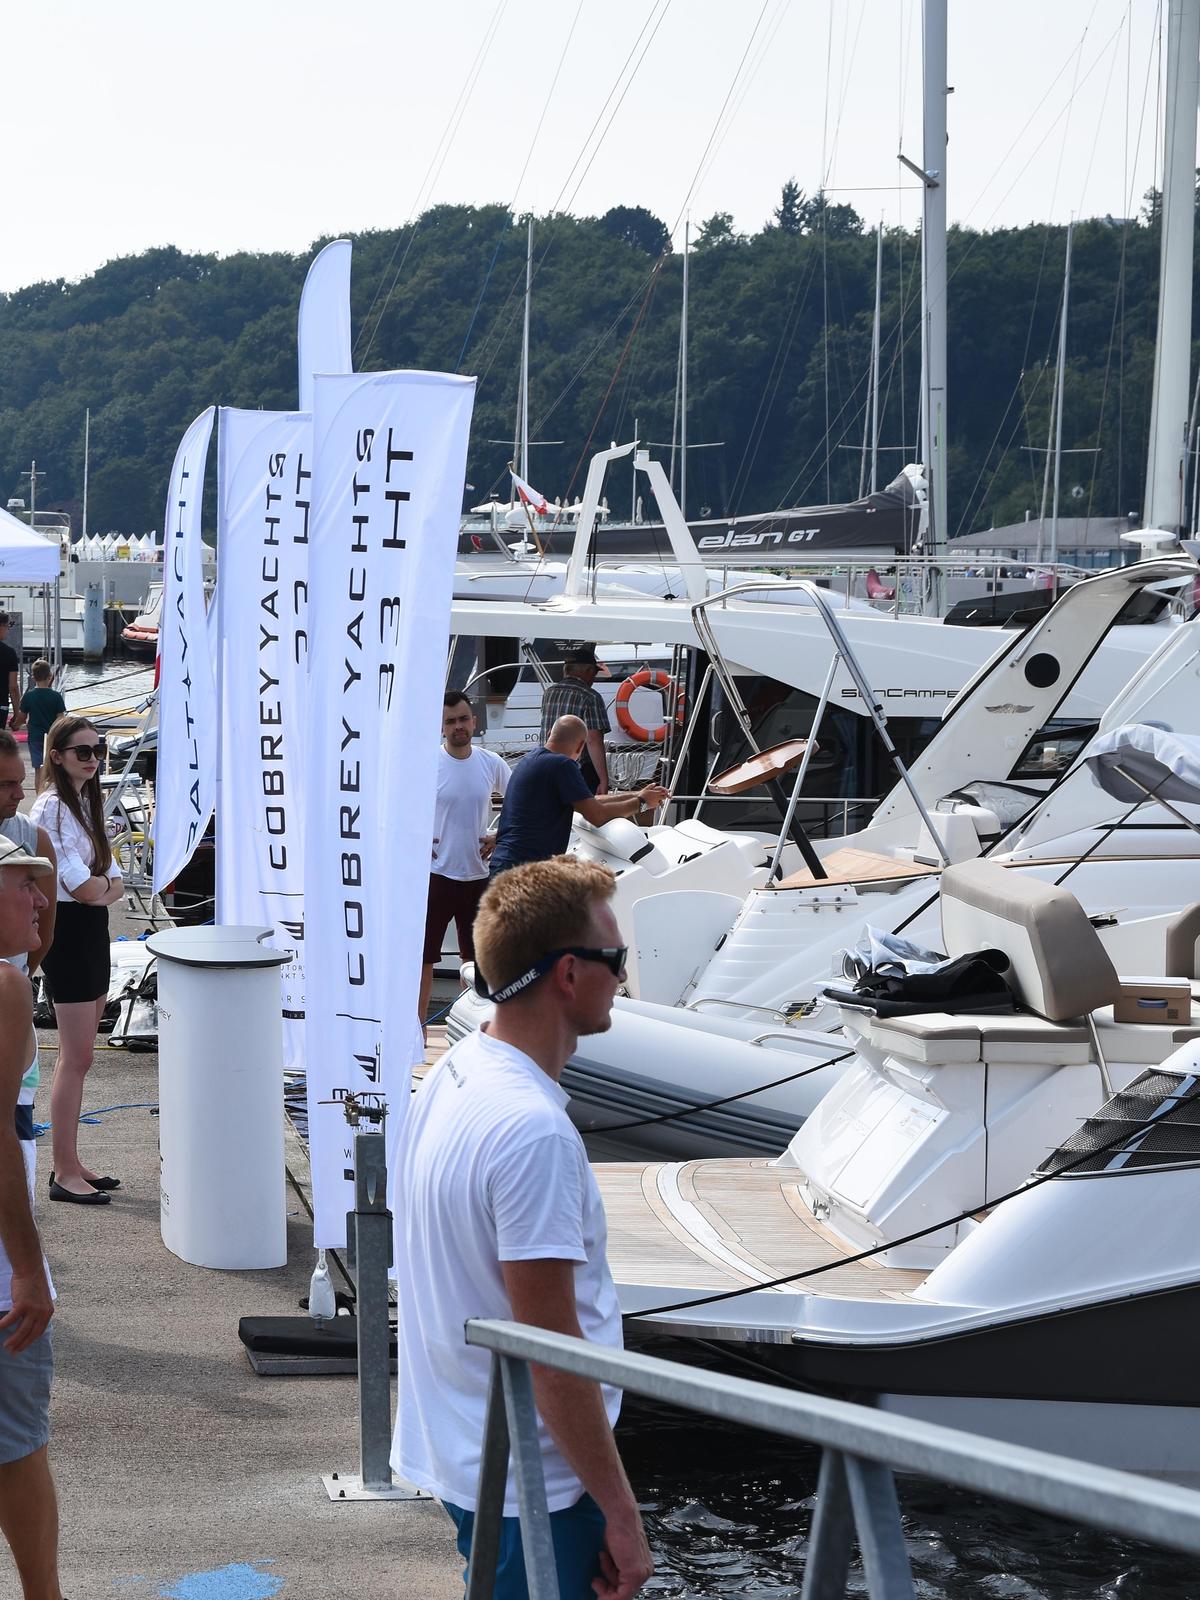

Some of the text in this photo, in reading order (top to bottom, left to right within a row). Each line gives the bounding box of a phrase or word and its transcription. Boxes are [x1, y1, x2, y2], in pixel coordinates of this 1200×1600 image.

[259, 452, 288, 871] COBREY YACHTS
[340, 428, 375, 986] COBREY YACHTS
[378, 427, 414, 712] 33 HT
[698, 529, 821, 549] elan GT
